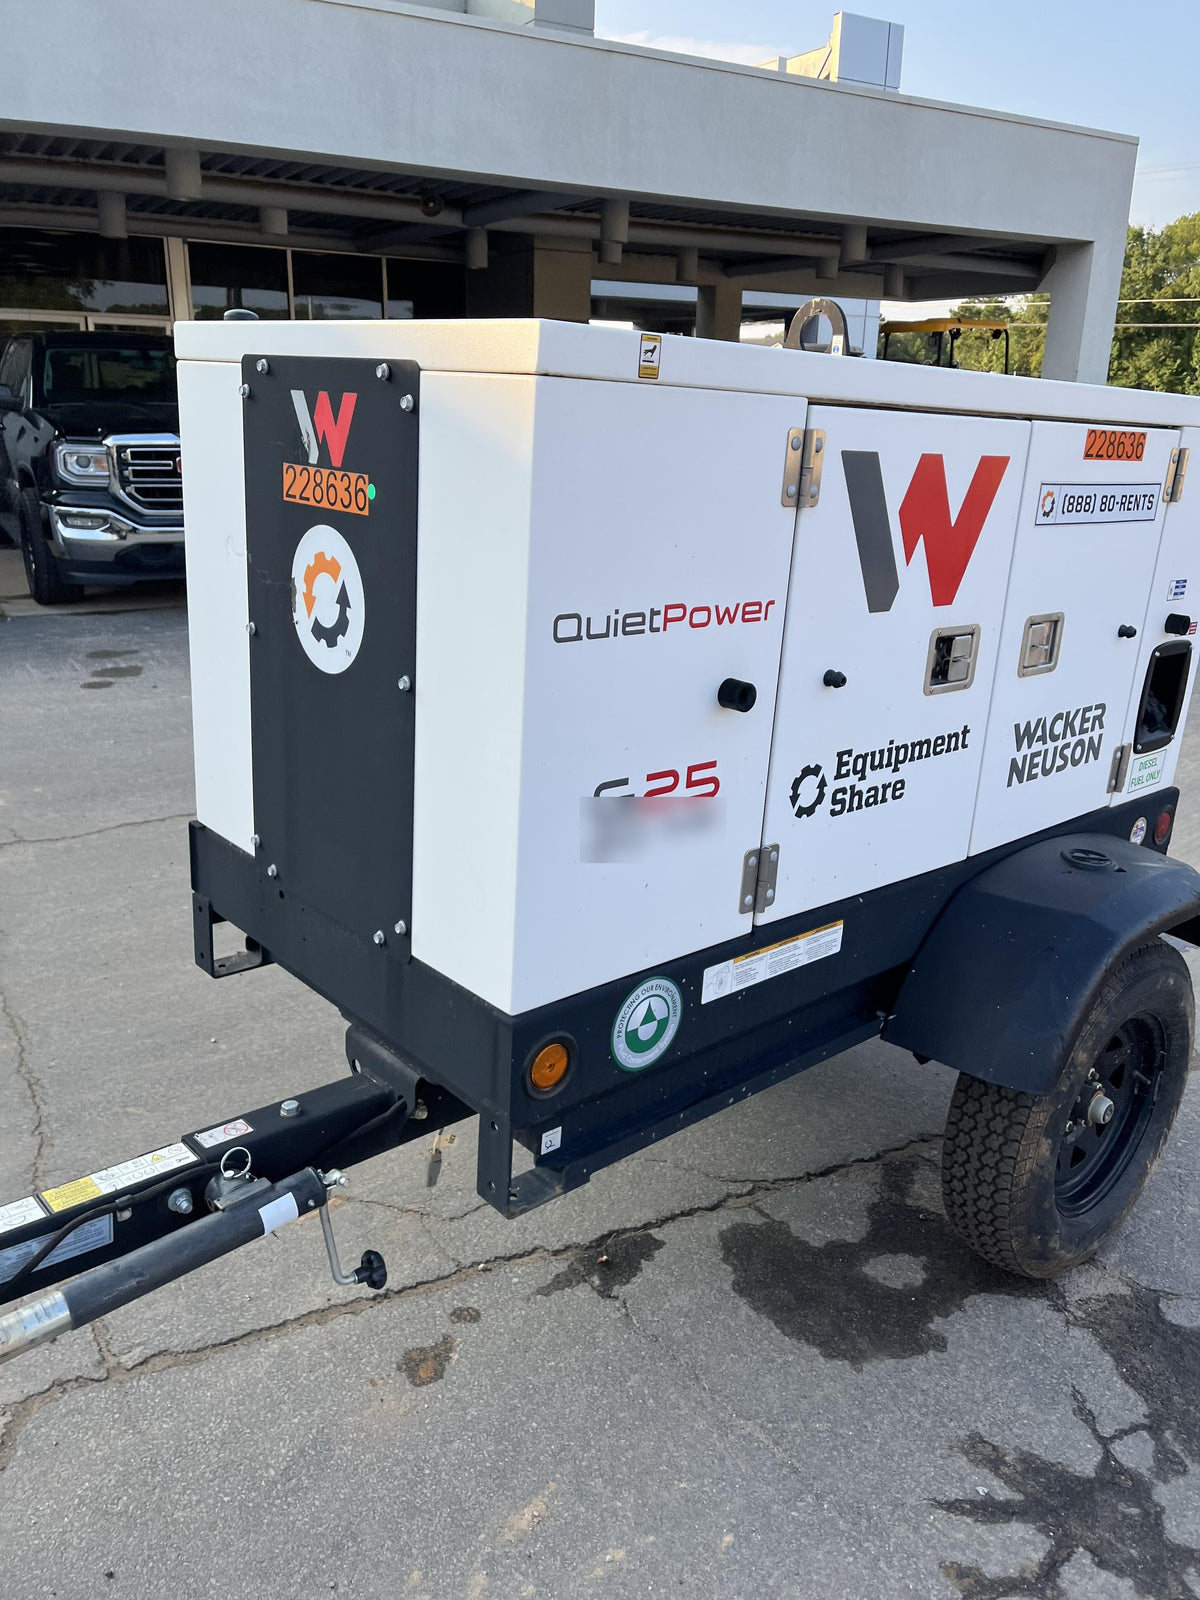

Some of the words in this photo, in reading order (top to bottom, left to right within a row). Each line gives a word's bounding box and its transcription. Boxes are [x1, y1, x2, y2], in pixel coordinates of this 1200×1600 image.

[1084, 429, 1146, 459] 228636
[285, 464, 367, 512] 228636
[1062, 493, 1097, 515] (888)
[1099, 493, 1155, 513] 80-RENTS
[553, 600, 775, 643] QuietPower
[1014, 703, 1107, 752] WACKER
[833, 725, 970, 781] Equipment
[1006, 733, 1103, 787] NEUSON
[1139, 758, 1157, 771] DIESEL
[829, 778, 905, 817] Share
[1131, 775, 1145, 787] FUEL
[1146, 770, 1161, 782] ONLY
[616, 994, 641, 1038] PROTECTING
[641, 984, 655, 996] OUR
